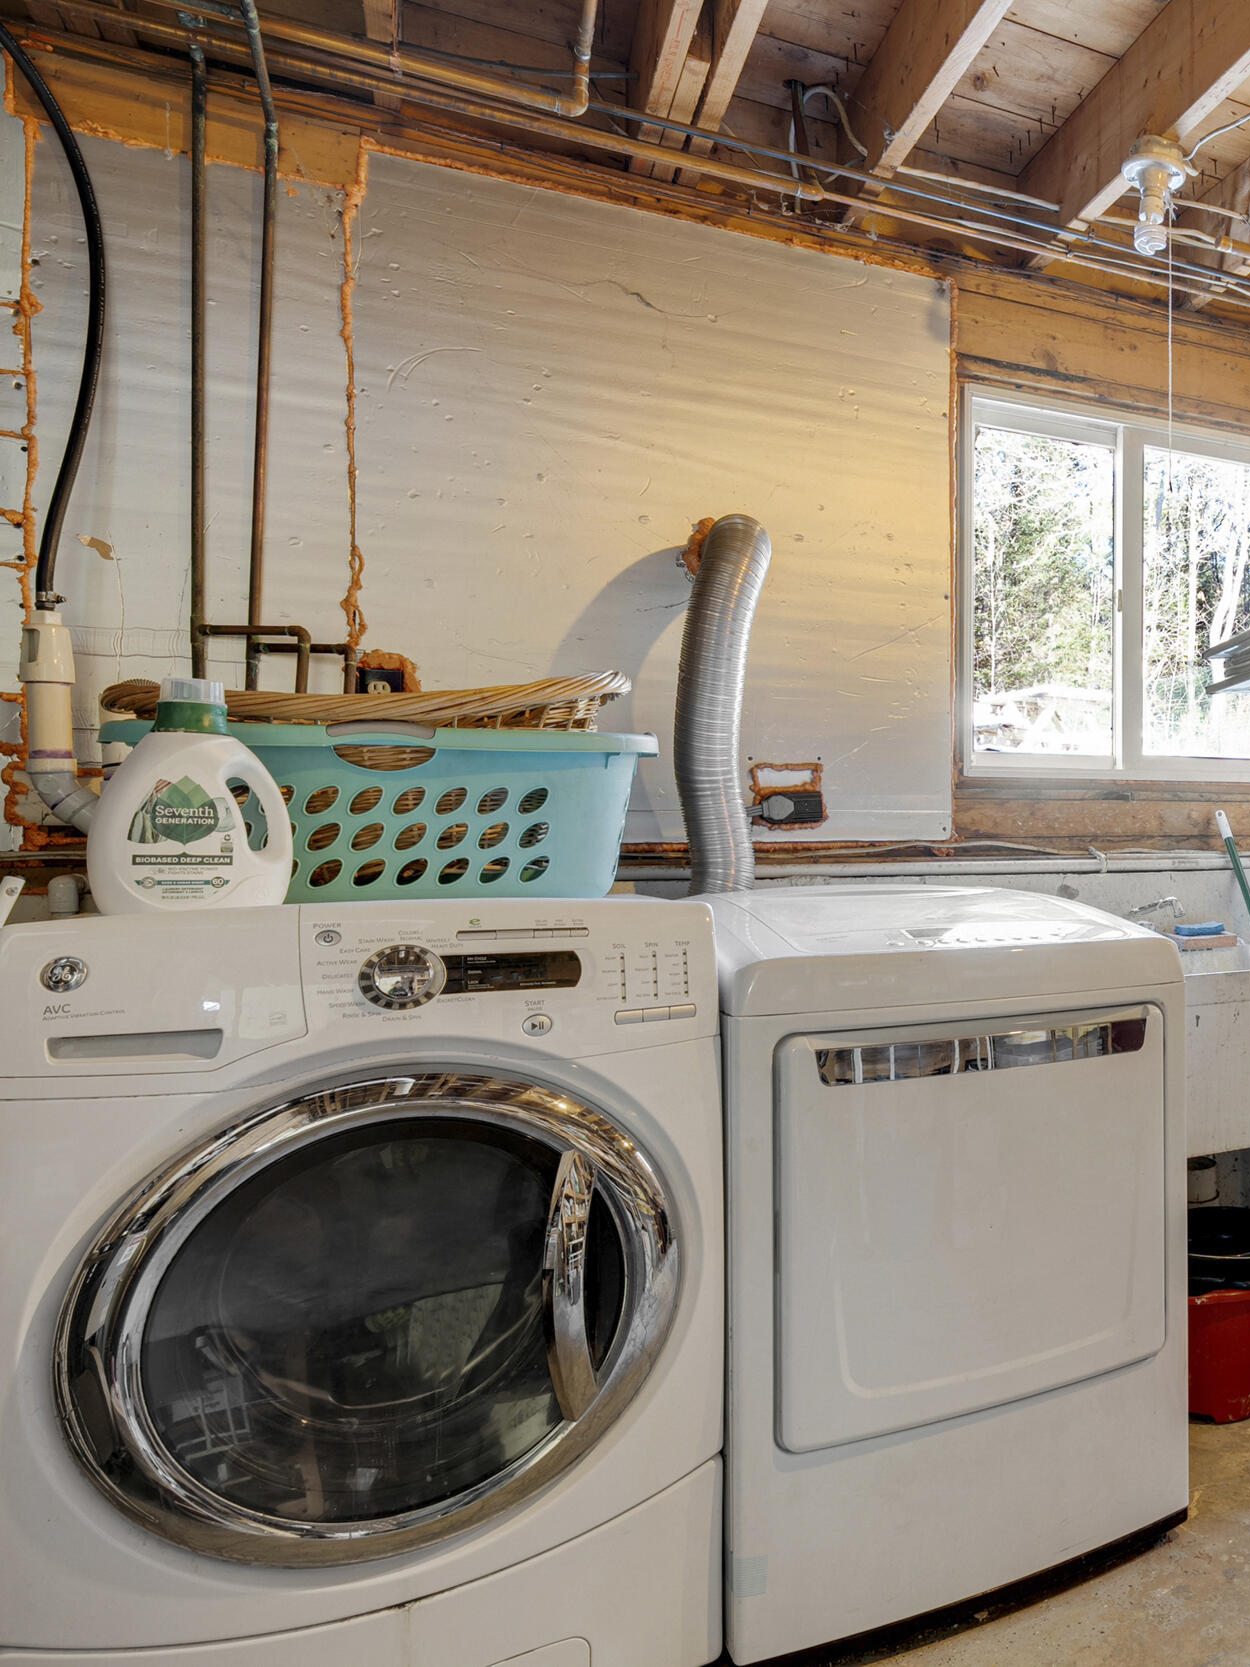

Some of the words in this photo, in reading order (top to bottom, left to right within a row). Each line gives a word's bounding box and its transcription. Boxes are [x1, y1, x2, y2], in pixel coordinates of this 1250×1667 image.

[155, 805, 214, 817] Seventh
[155, 817, 215, 825] GENERATION
[312, 922, 342, 930] POWER
[43, 1003, 71, 1015] AVC
